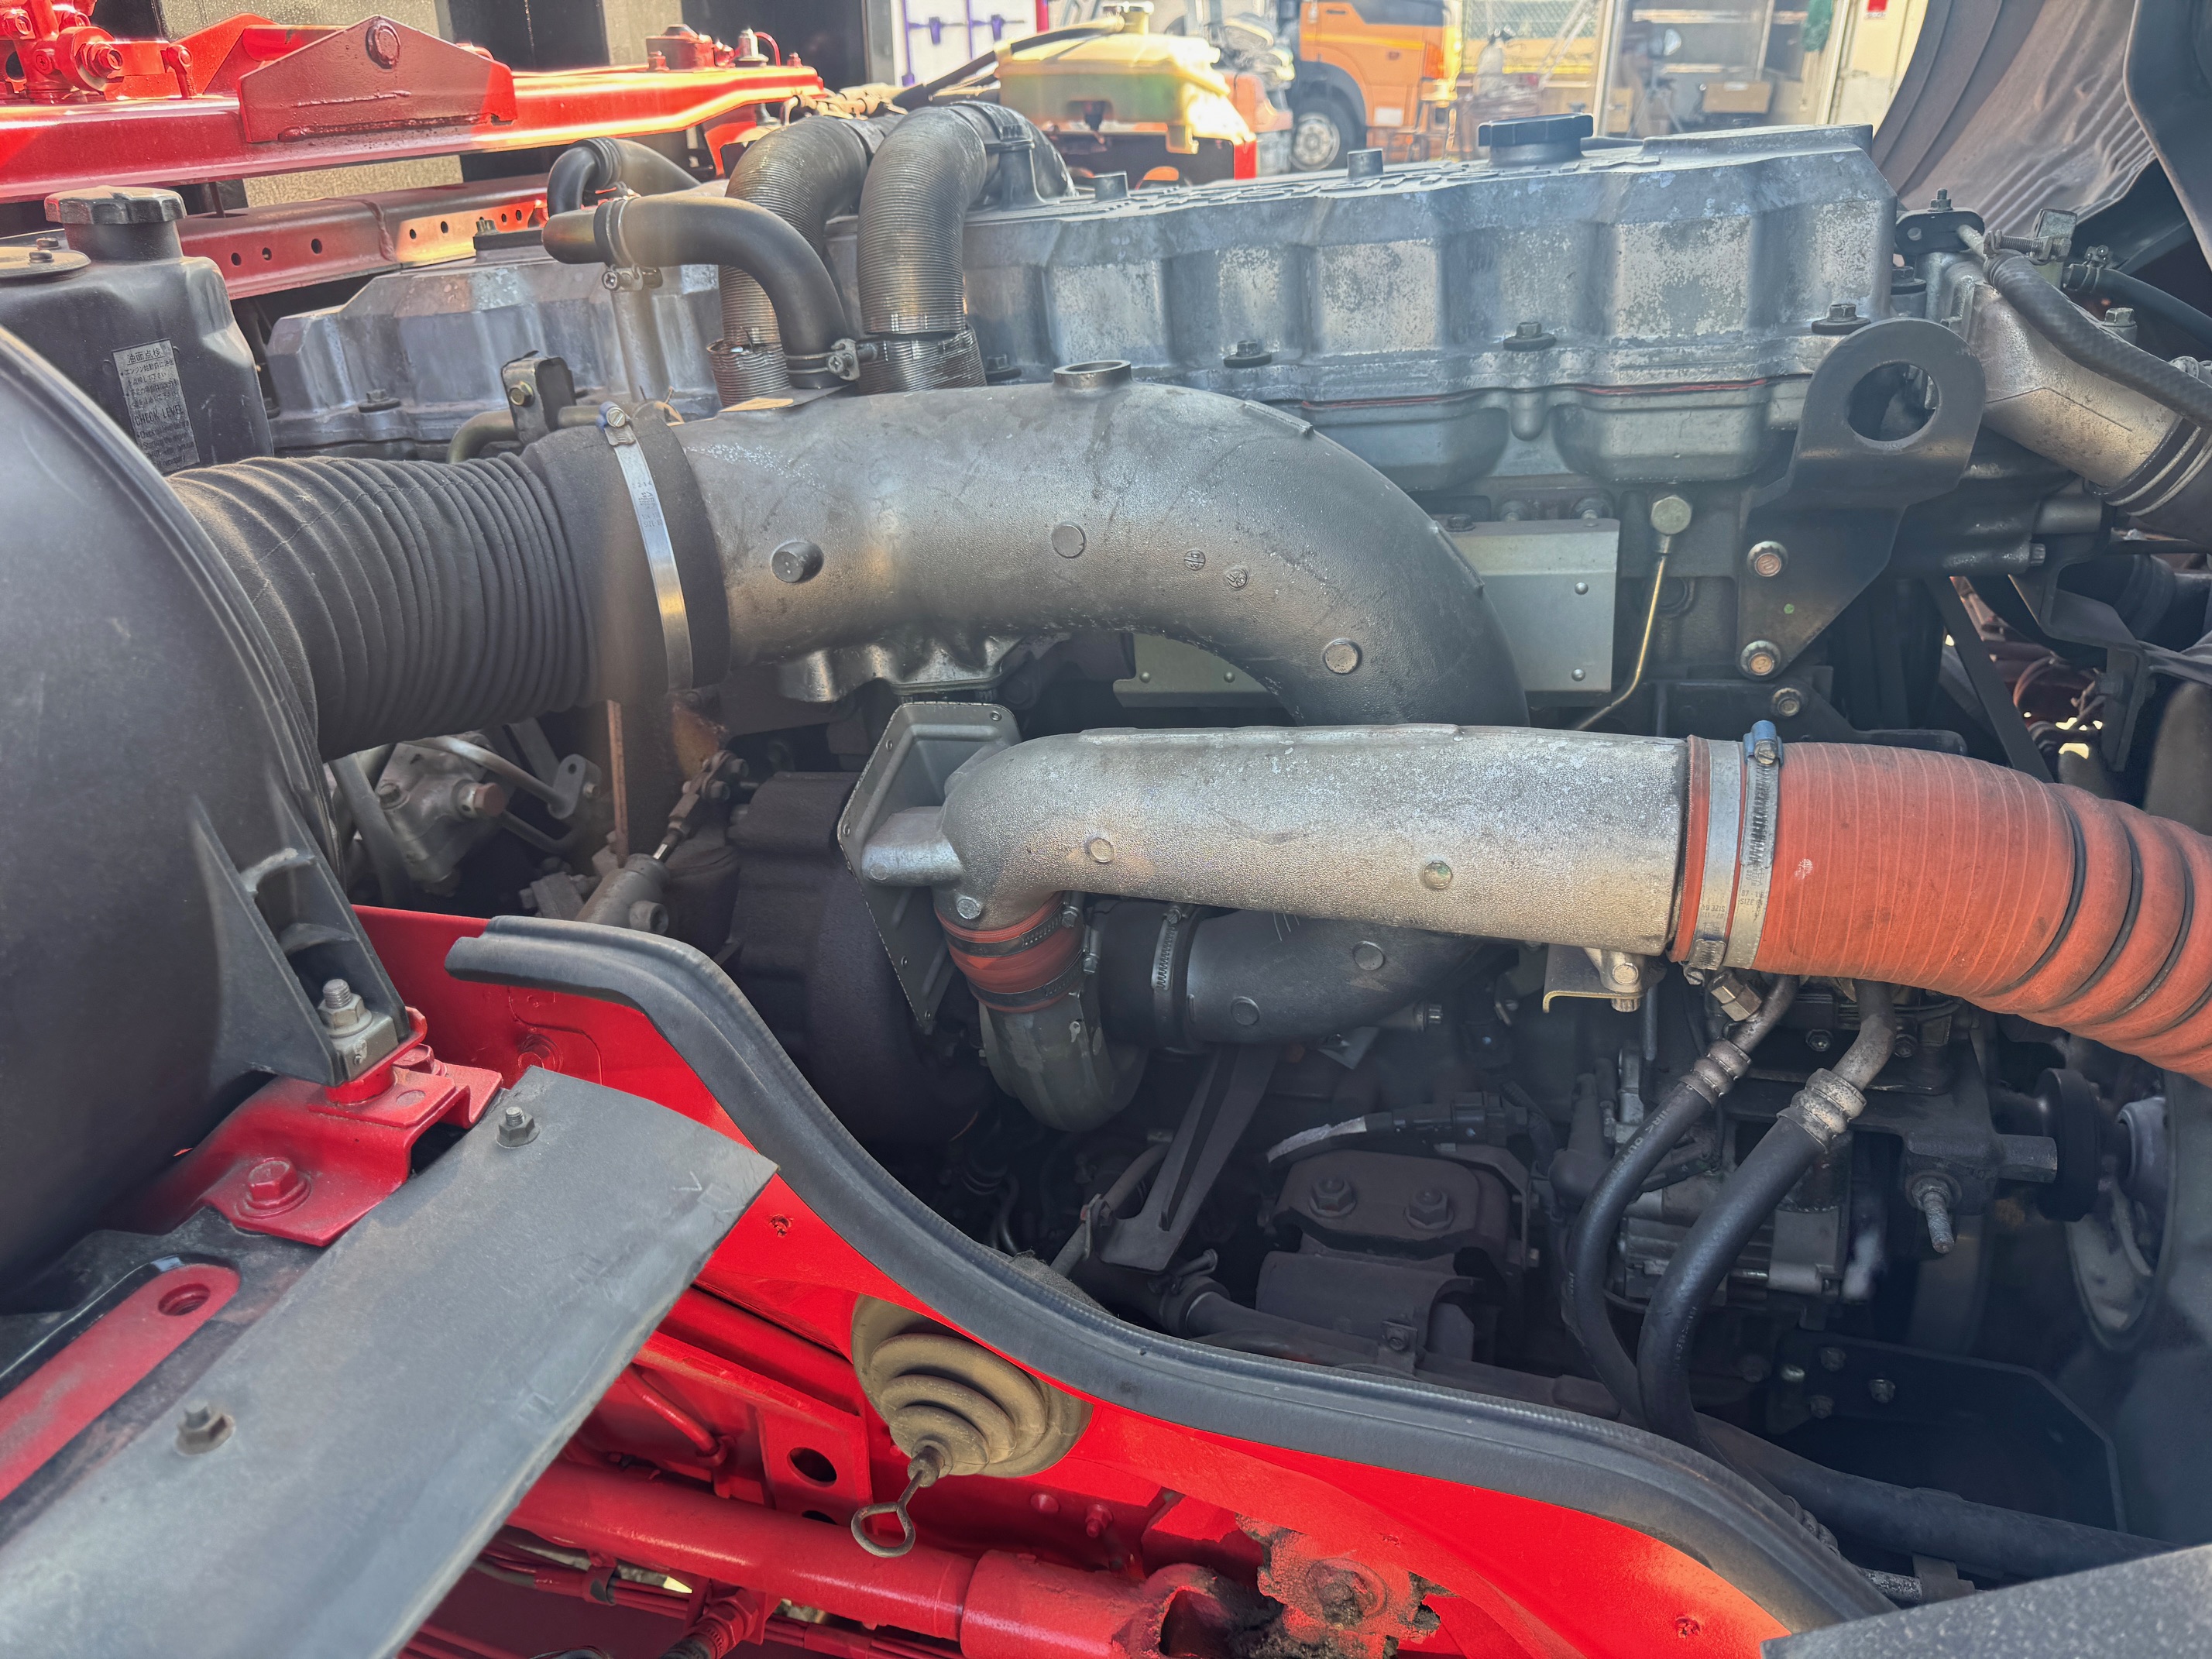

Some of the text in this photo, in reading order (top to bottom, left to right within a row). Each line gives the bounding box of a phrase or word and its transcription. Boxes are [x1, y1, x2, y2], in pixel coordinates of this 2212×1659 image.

[127, 348, 162, 364] 油面点検
[135, 404, 184, 426] CHECK LEVEL
[1740, 898, 1755, 906] SIZE
